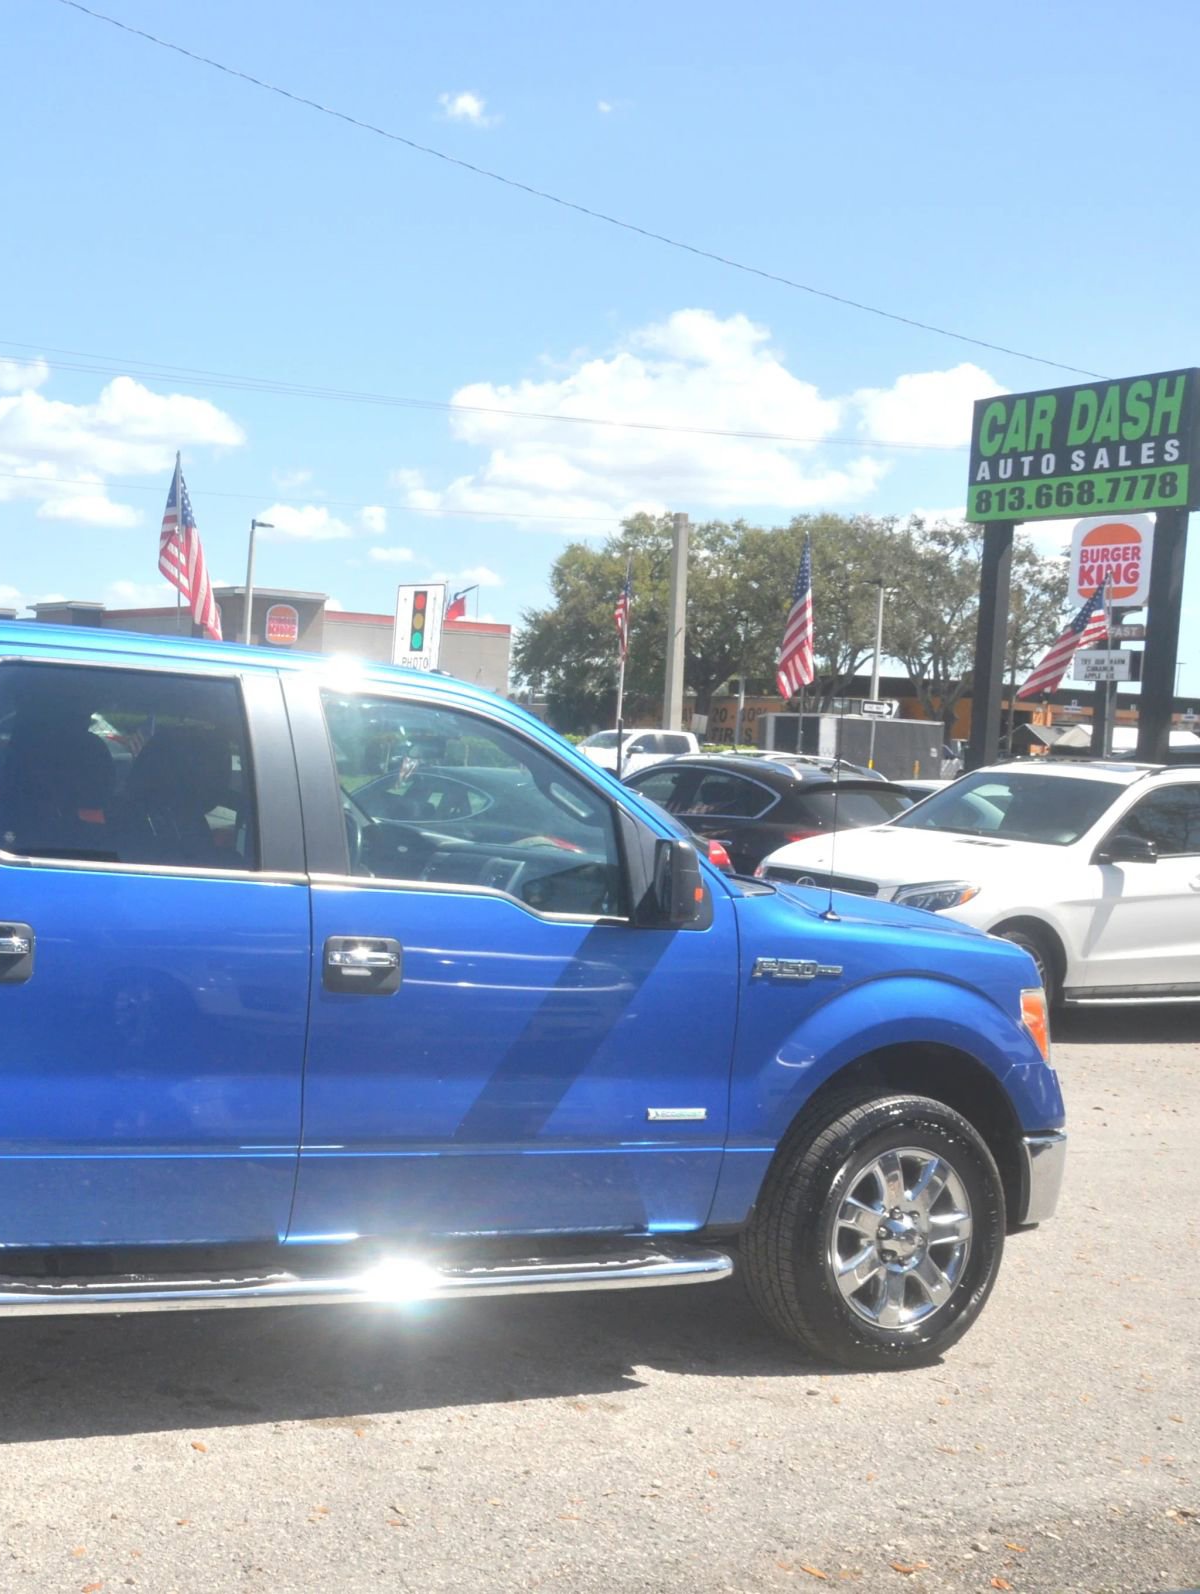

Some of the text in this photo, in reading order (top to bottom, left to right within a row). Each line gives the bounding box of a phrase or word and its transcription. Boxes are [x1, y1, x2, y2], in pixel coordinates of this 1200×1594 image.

[979, 374, 1187, 457] CAR DASH
[975, 439, 1180, 482] AUTO SALES
[975, 471, 1178, 514] 813.668.7778
[1080, 545, 1141, 564] BURGER
[1078, 562, 1140, 586] KING
[711, 727, 753, 743] TIRS
